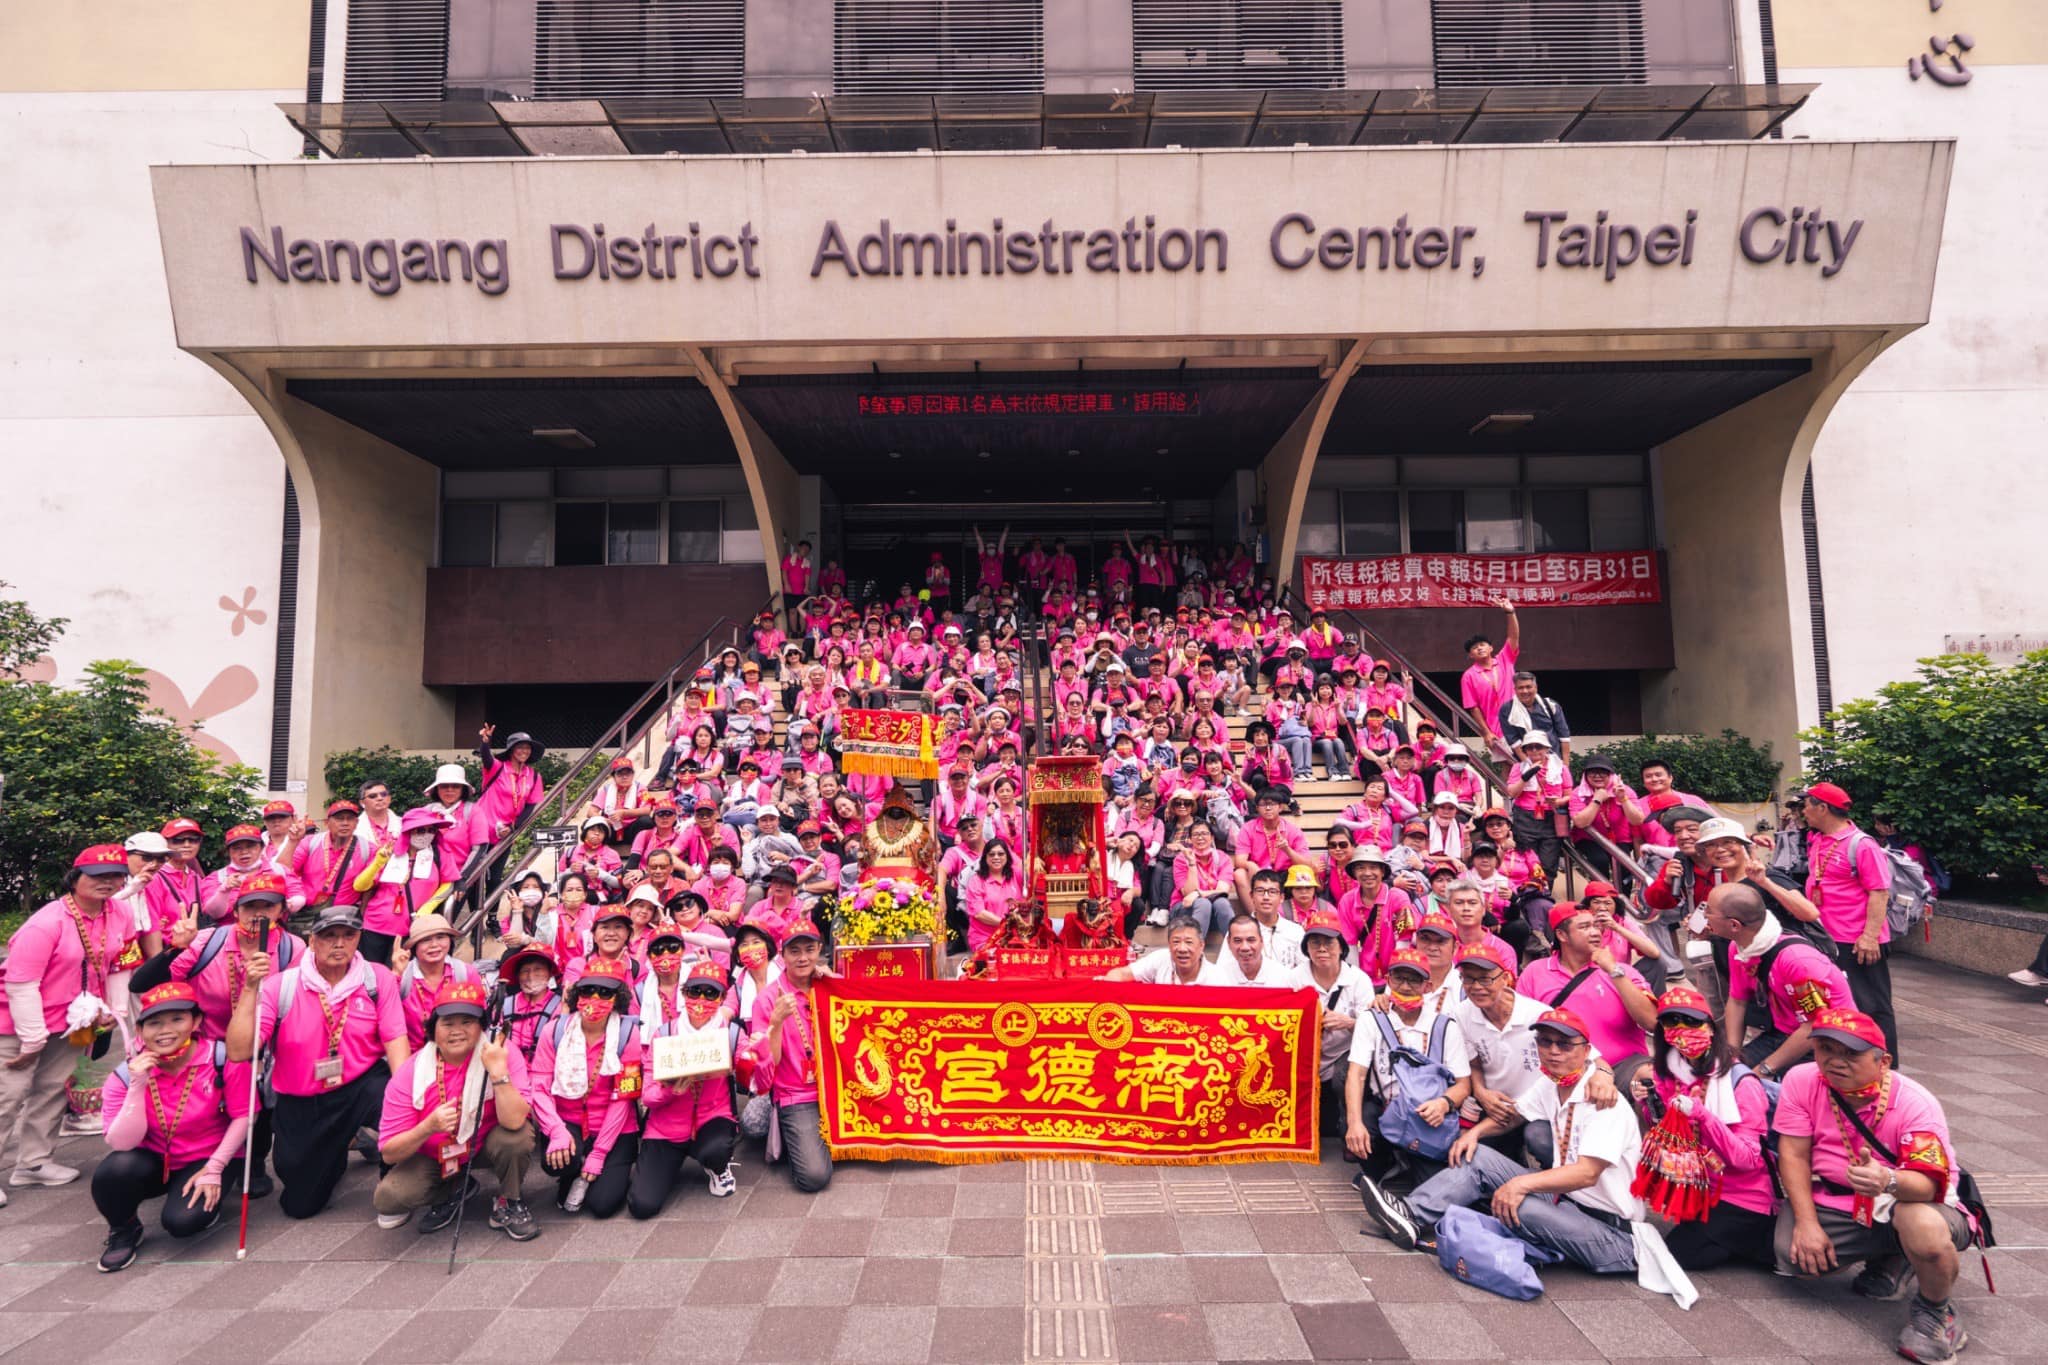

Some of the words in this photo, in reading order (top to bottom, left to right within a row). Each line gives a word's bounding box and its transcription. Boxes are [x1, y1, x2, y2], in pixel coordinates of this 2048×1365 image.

[240, 227, 511, 299] Nangang
[550, 222, 761, 282] District
[810, 215, 1229, 280] Administration
[1269, 212, 1486, 280] Center,
[1523, 209, 1698, 283] Taipei
[1738, 206, 1864, 280] City
